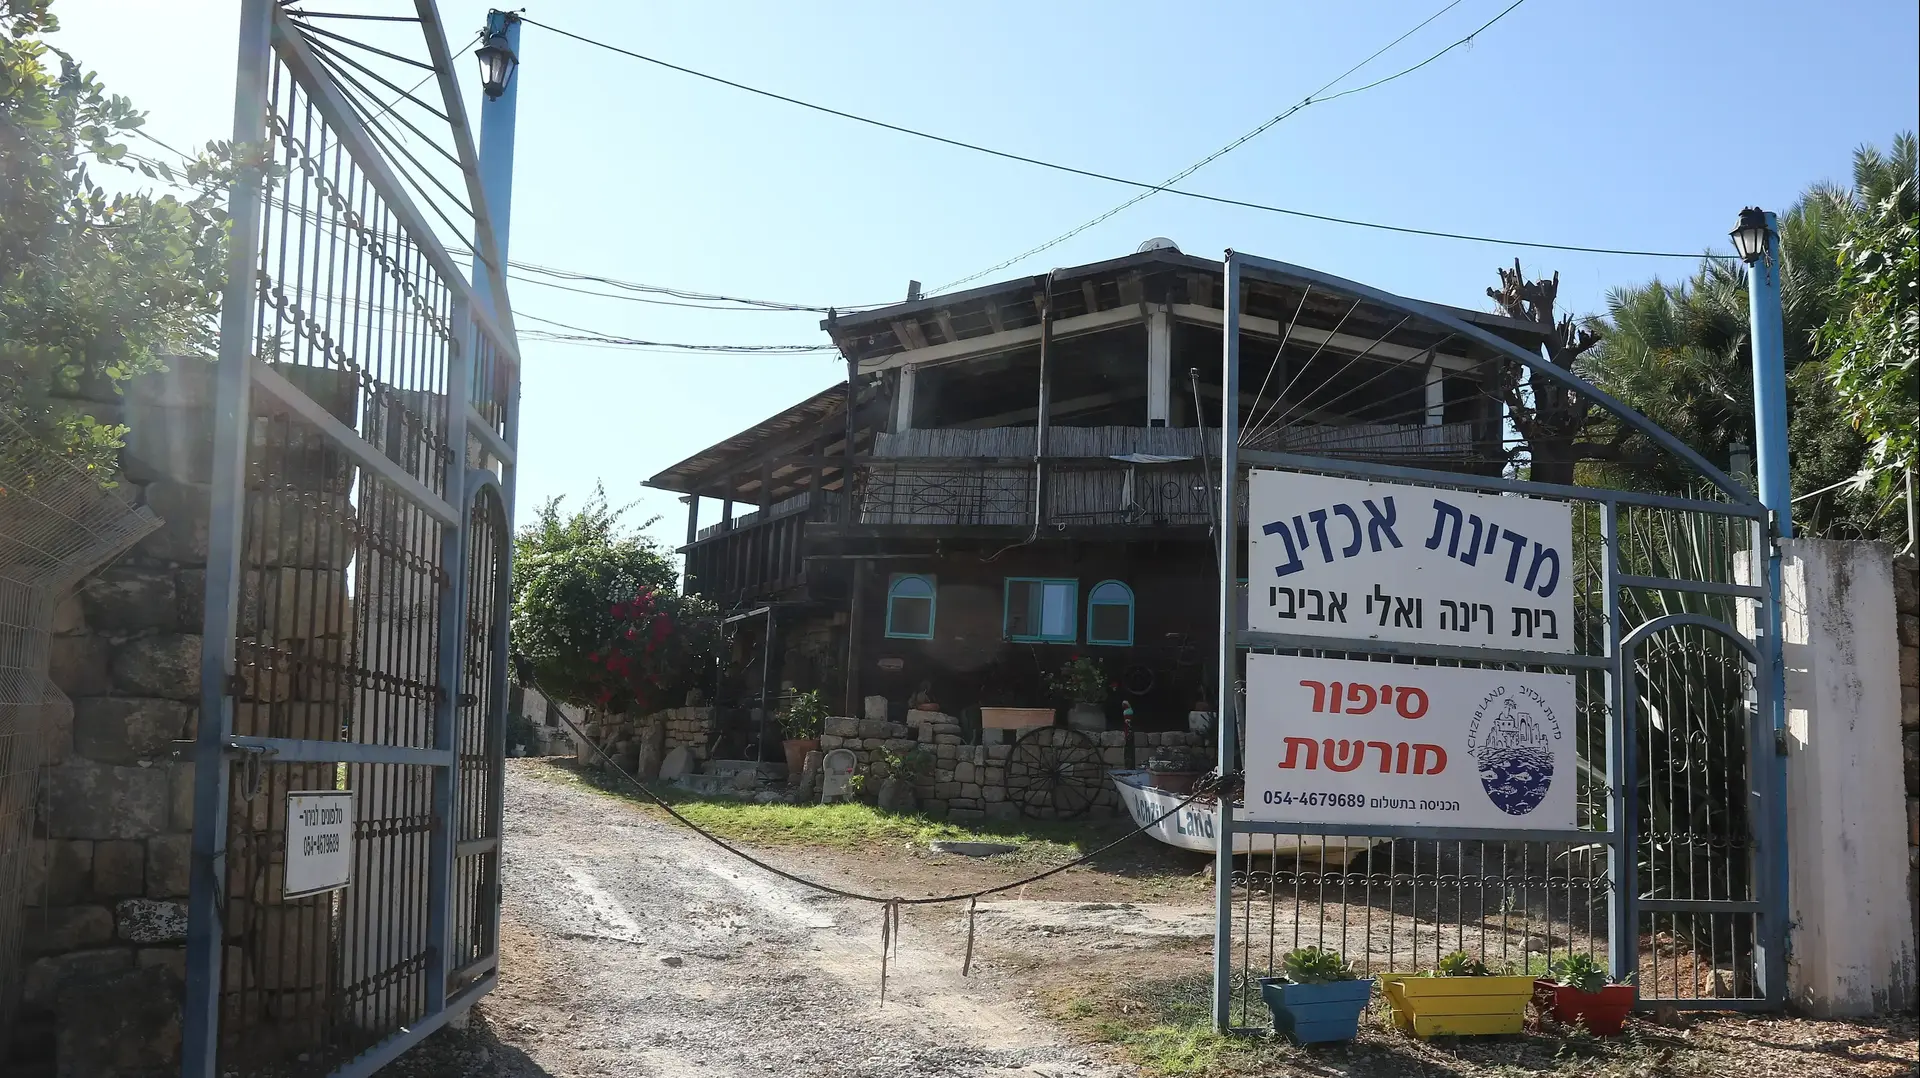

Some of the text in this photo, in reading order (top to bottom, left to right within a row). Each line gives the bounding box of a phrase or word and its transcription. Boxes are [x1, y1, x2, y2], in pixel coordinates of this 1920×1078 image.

[1262, 496, 1560, 598] מדינת אכזיב
[1269, 584, 1559, 640] בית רינה ואלי אביבי
[1299, 680, 1429, 719] סיפור
[1467, 686, 1505, 758] ACHZIB LAND
[1519, 685, 1562, 740] מדינת אכזיב
[1278, 736, 1448, 775] מורשת
[1176, 805, 1215, 838] Land
[1263, 790, 1460, 812] הכניסה בתשלום 054-4679689
